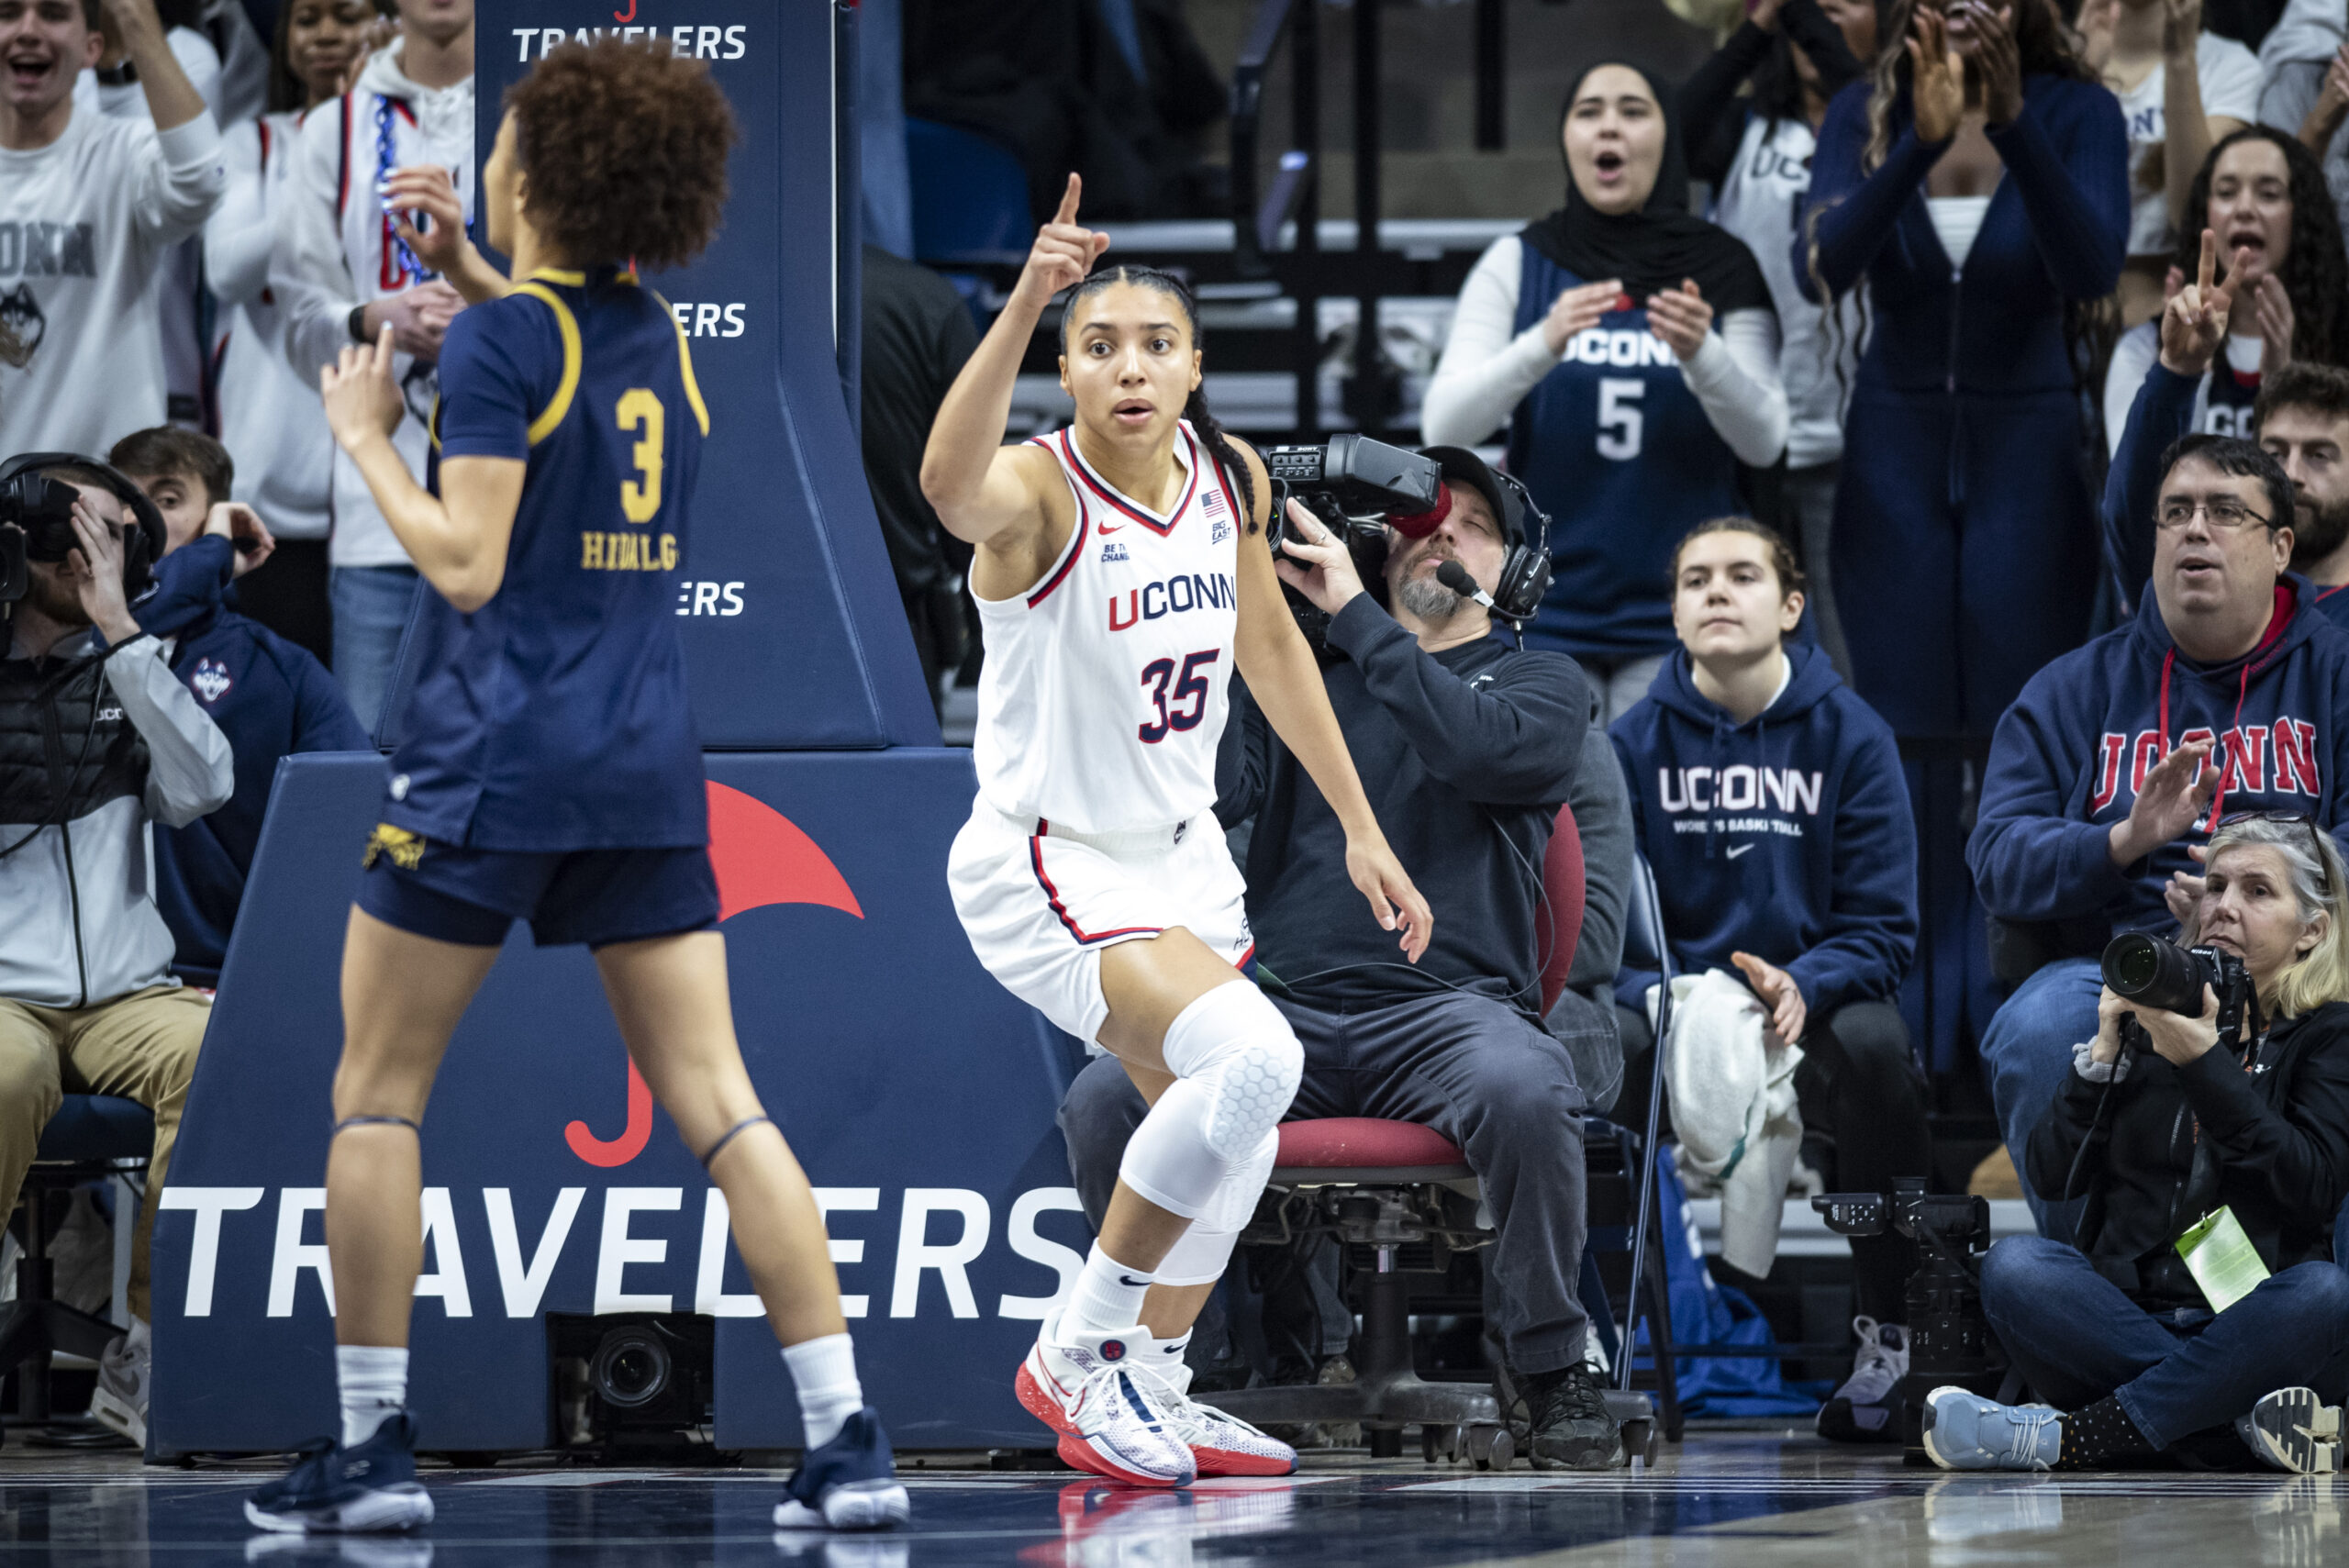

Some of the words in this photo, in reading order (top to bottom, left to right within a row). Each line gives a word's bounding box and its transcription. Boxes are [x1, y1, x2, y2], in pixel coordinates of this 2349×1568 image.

[1596, 377, 1645, 461] 5
[615, 387, 664, 524] 3
[1104, 543, 1116, 553] BE
[1212, 520, 1226, 532] BIG
[1212, 527, 1230, 540] EAST
[1109, 573, 1236, 632] UCONN
[1139, 648, 1220, 744] 35
[1659, 764, 1823, 816] UCONN
